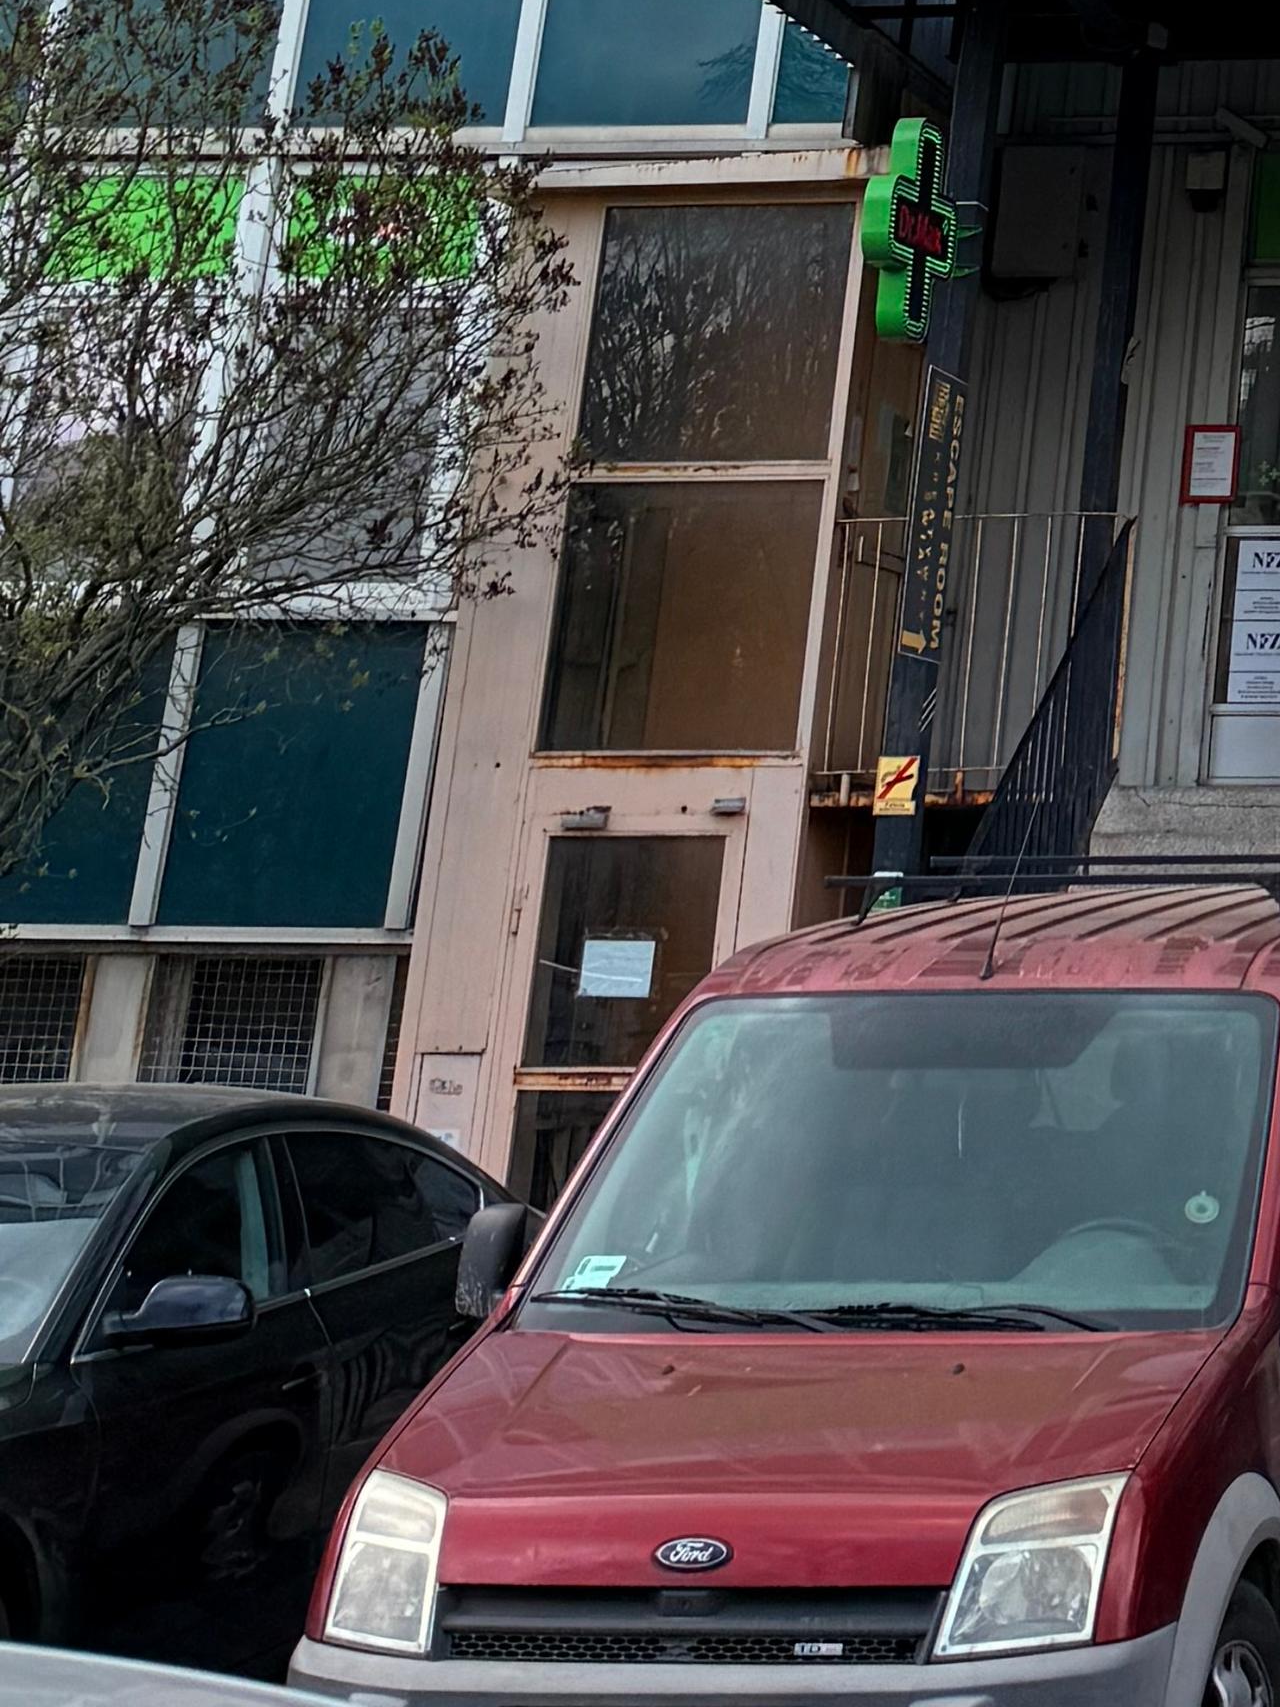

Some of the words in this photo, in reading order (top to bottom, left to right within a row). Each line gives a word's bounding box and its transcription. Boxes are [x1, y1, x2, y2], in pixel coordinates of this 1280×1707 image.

[942, 394, 966, 531] ESCAPE
[930, 541, 950, 651] ROOM
[1246, 633, 1280, 650] NFZ
[670, 1540, 713, 1563] Ford
